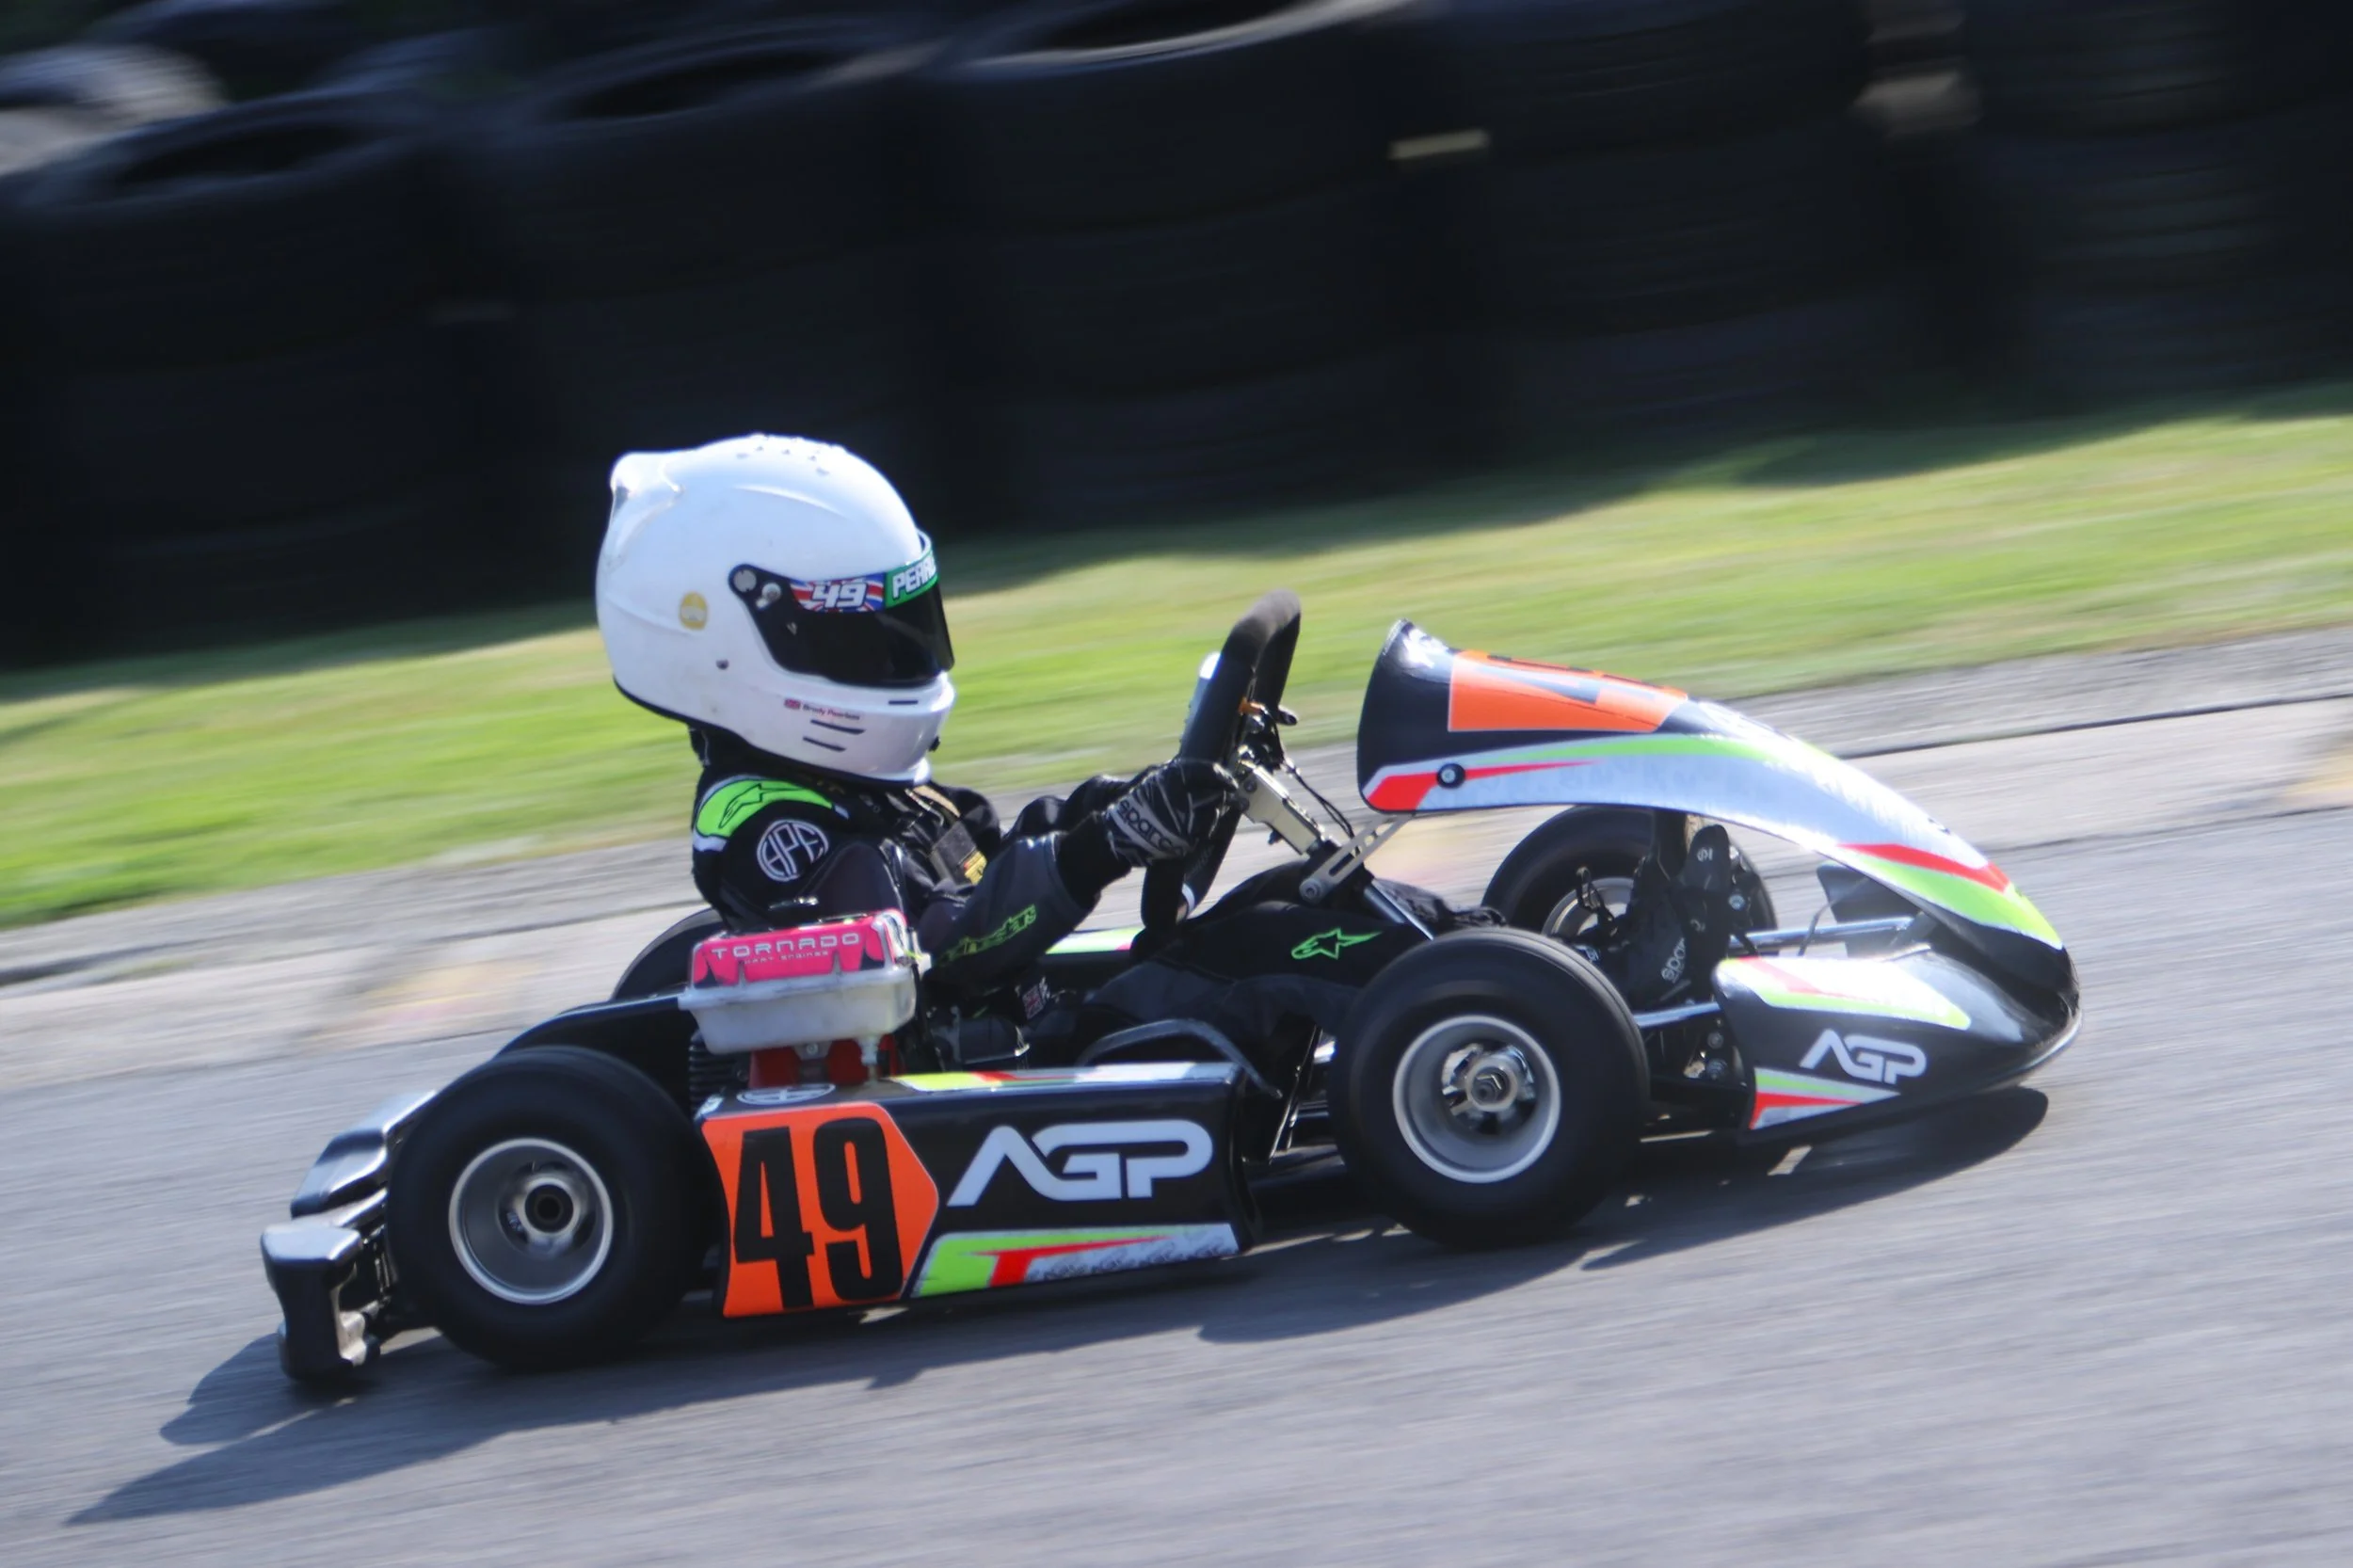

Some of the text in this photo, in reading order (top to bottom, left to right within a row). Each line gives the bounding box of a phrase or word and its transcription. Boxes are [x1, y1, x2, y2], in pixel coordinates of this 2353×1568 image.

[811, 582, 867, 608] 49
[712, 933, 859, 960] TORNADO
[1801, 1029, 1927, 1084] AGP
[947, 1119, 1213, 1207] AGP
[733, 1116, 903, 1310] 49
